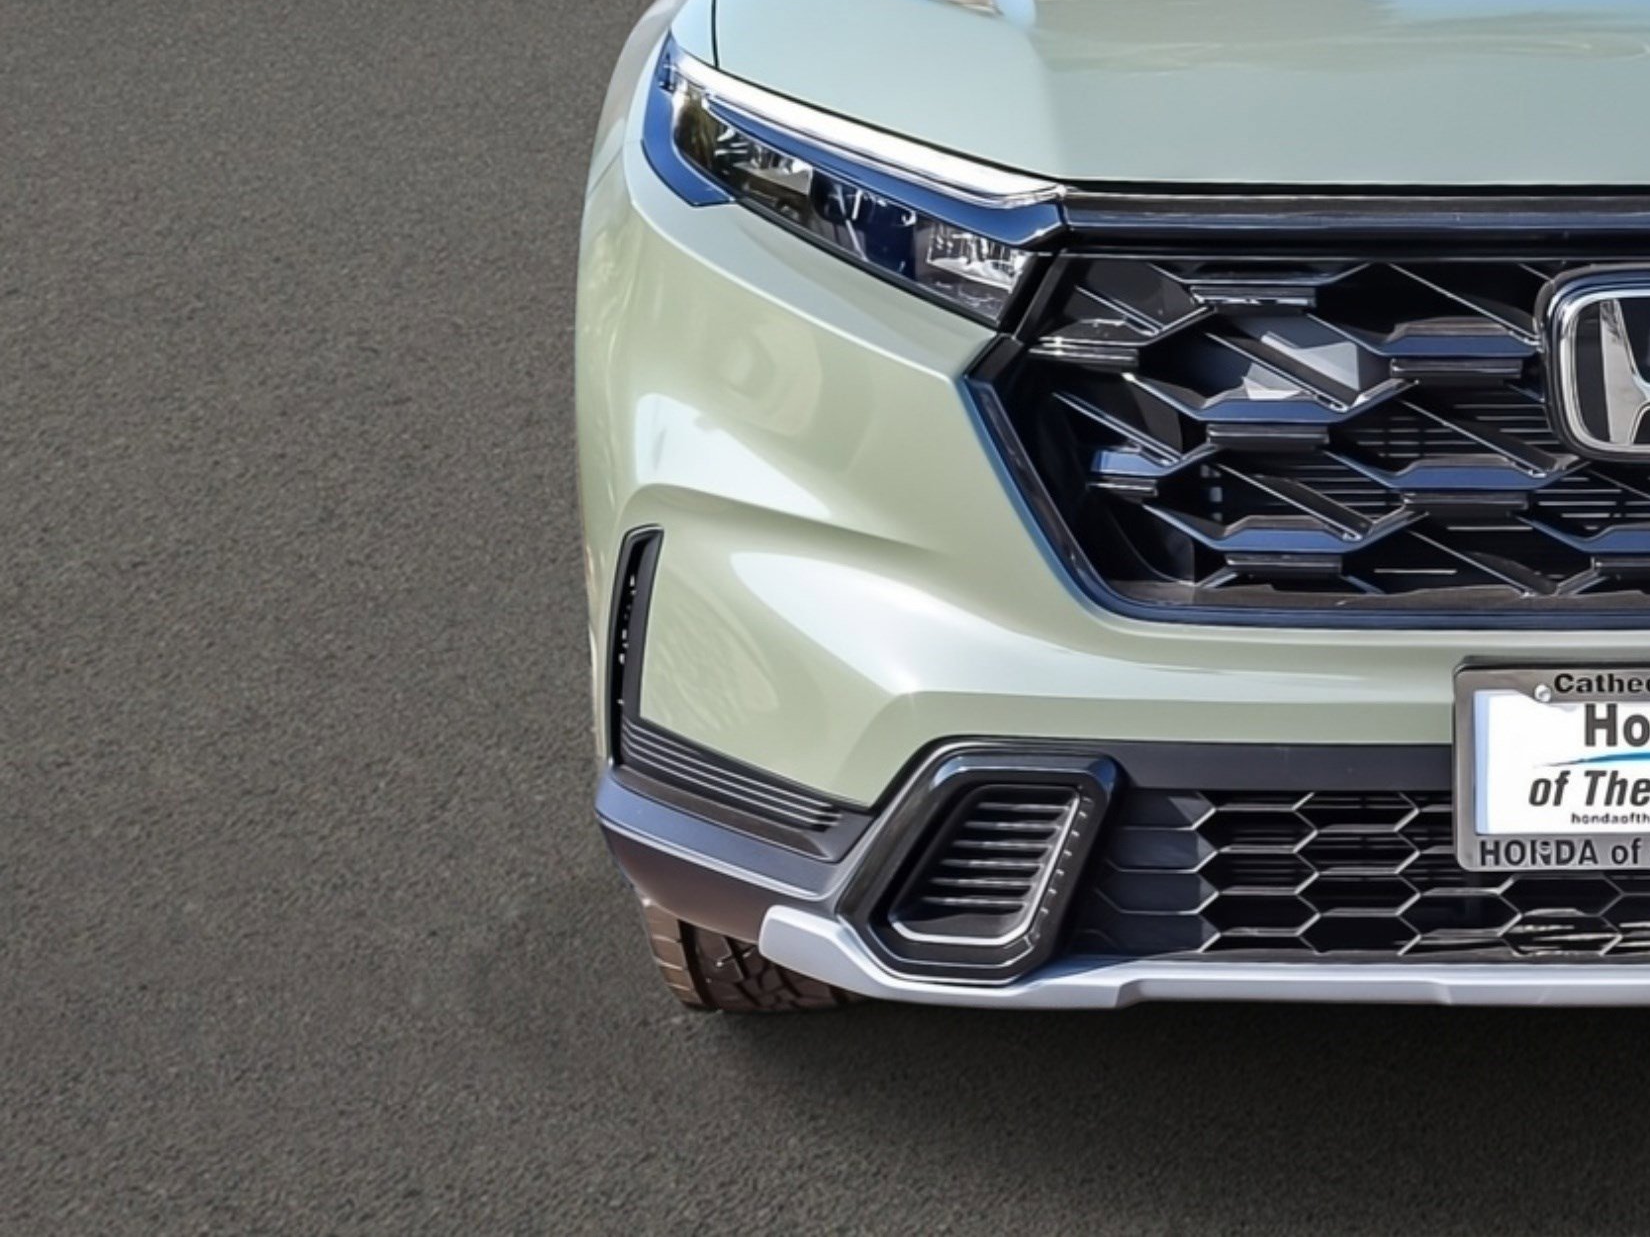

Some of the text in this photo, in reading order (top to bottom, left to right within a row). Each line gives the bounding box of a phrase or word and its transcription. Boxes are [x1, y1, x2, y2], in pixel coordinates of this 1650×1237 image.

[1528, 771, 1570, 807] of
[1479, 838, 1599, 867] HONDA
[1610, 838, 1641, 865] of
